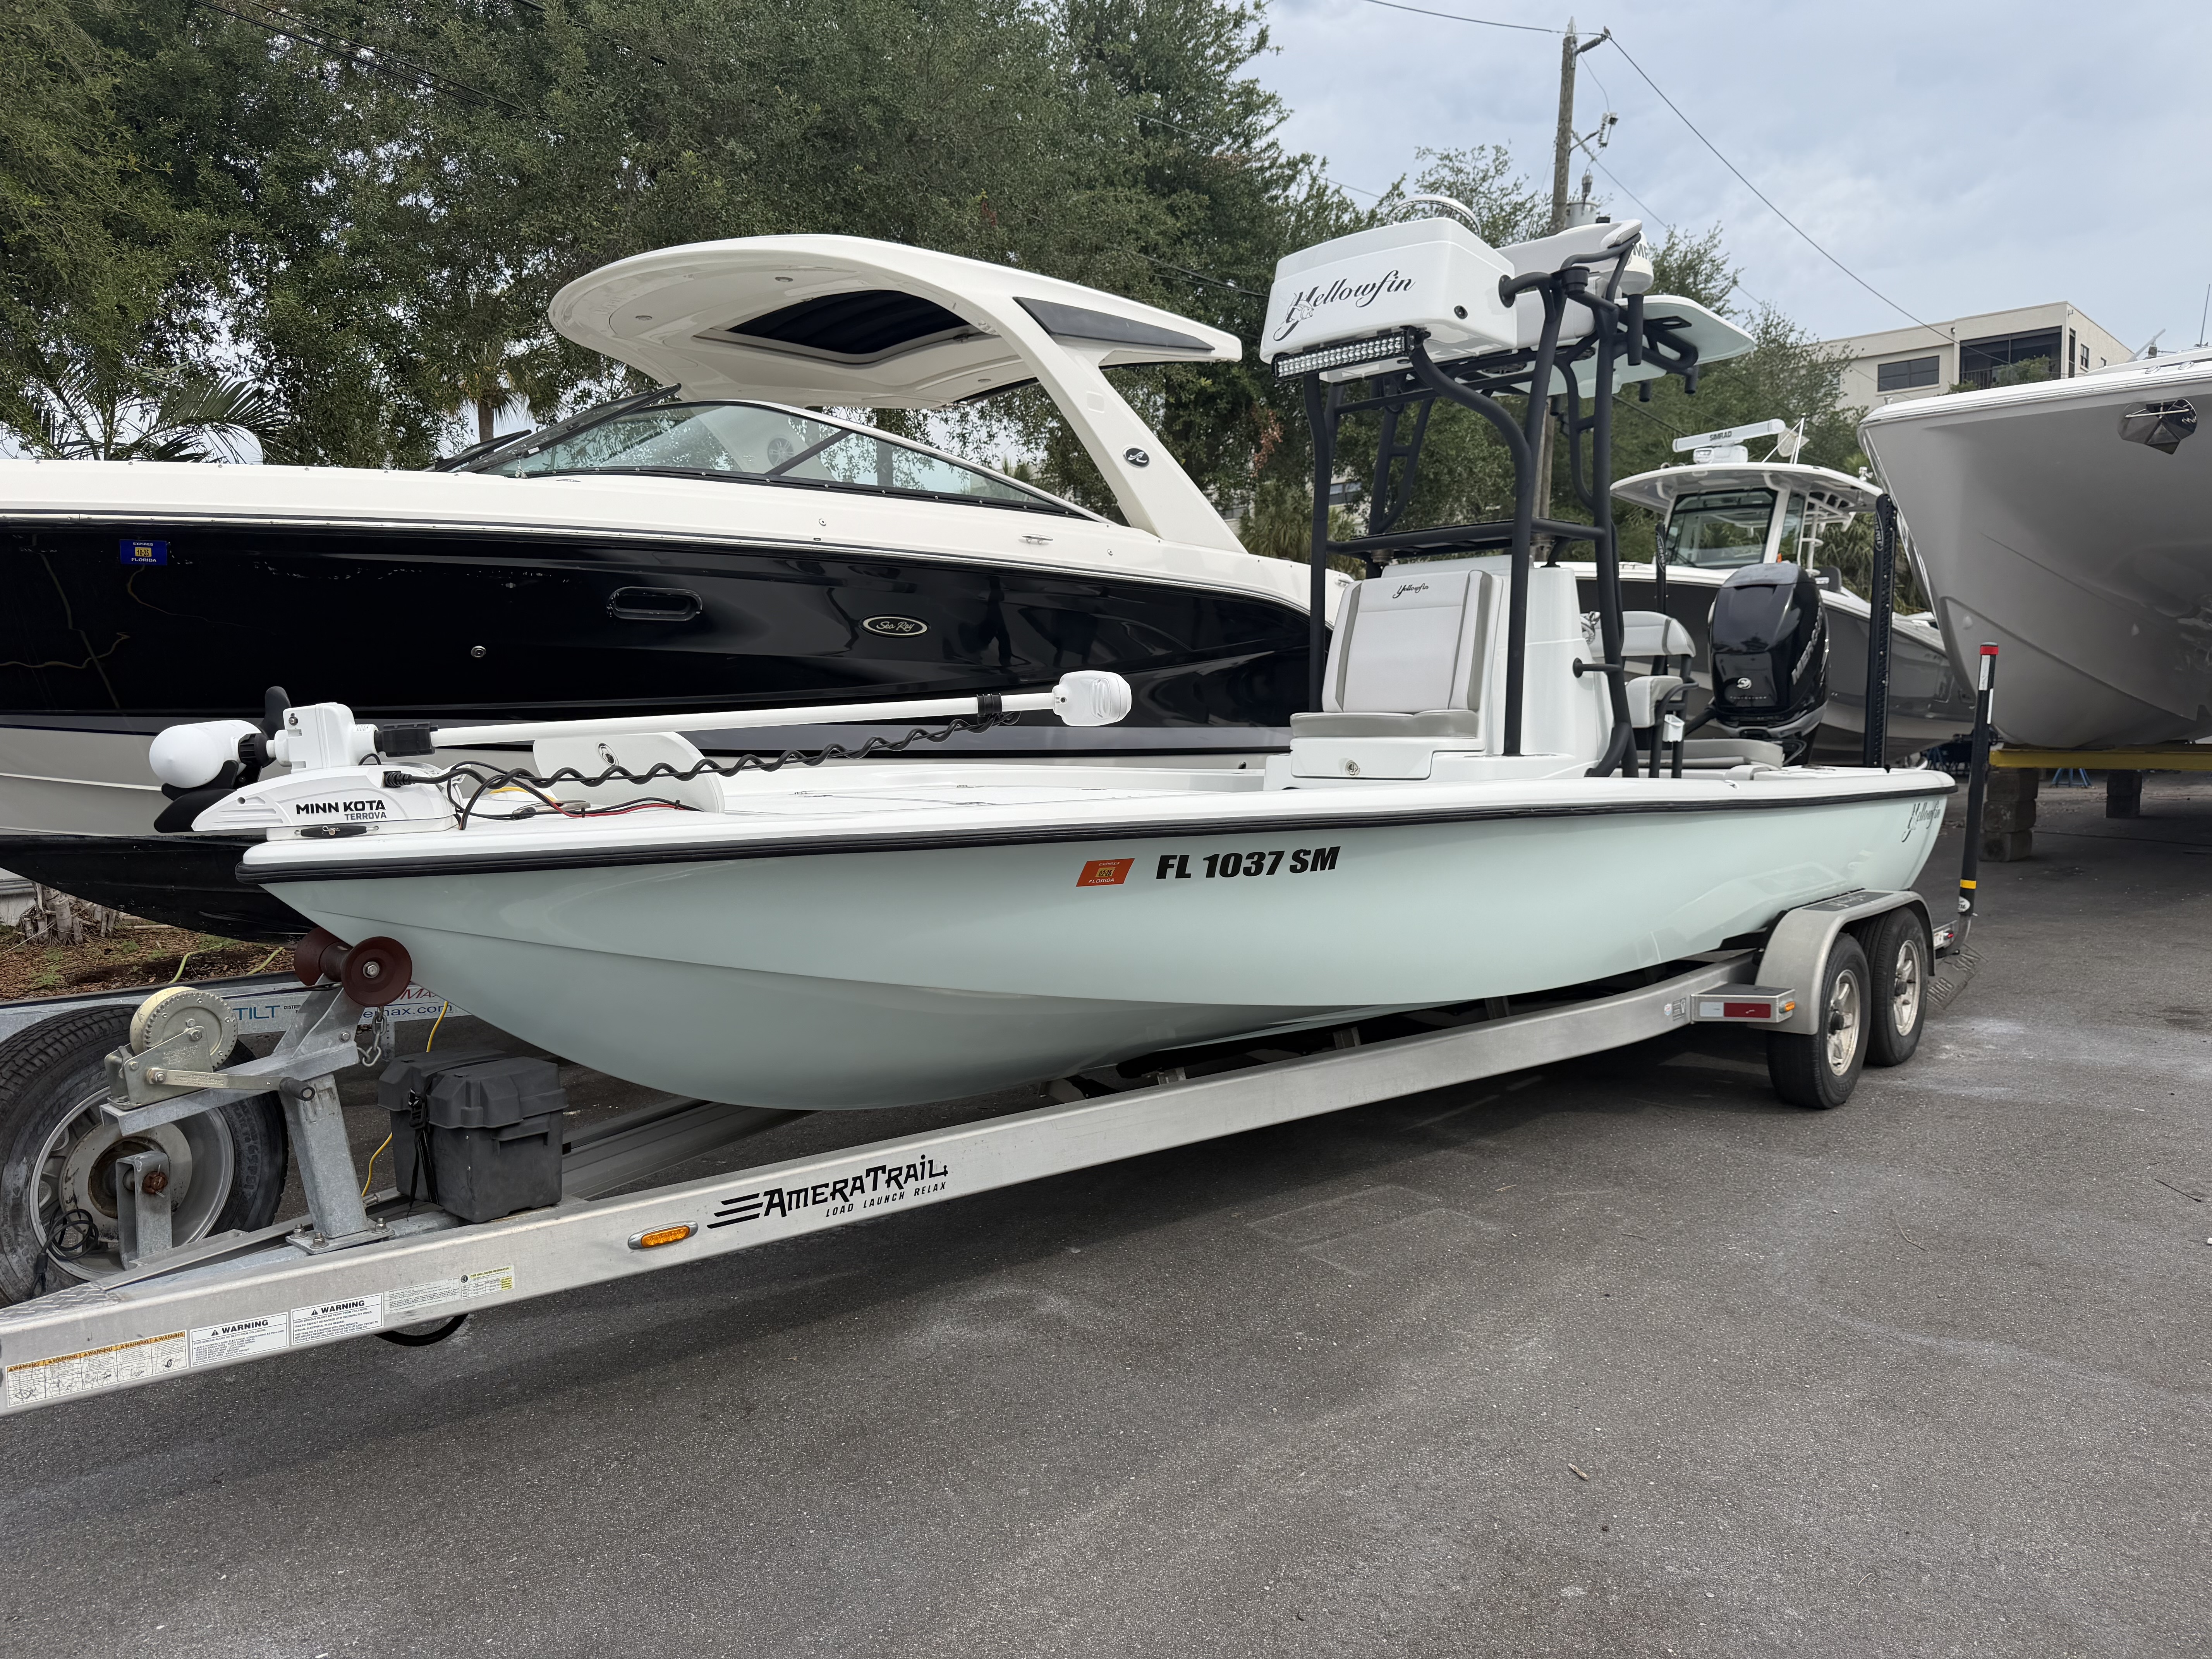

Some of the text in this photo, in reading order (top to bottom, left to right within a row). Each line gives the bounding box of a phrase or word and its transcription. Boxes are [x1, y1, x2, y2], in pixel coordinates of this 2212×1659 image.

[1273, 270, 1415, 341] Yellowfin
[1709, 431, 1732, 441] SIMRAD
[1393, 584, 1429, 598] Yellowfin
[876, 621, 915, 632] Sea Ray
[296, 800, 386, 814] MINN KOTA
[344, 812, 386, 821] TERROVA
[1156, 846, 1341, 879] FL 1037 SM
[233, 1005, 280, 1020] TILT
[826, 1181, 946, 1218] LOAD LAUNCH RELAX
[321, 1300, 365, 1314] WARNING
[222, 1320, 268, 1334] WARNING
[160, 1333, 184, 1341] WARNING
